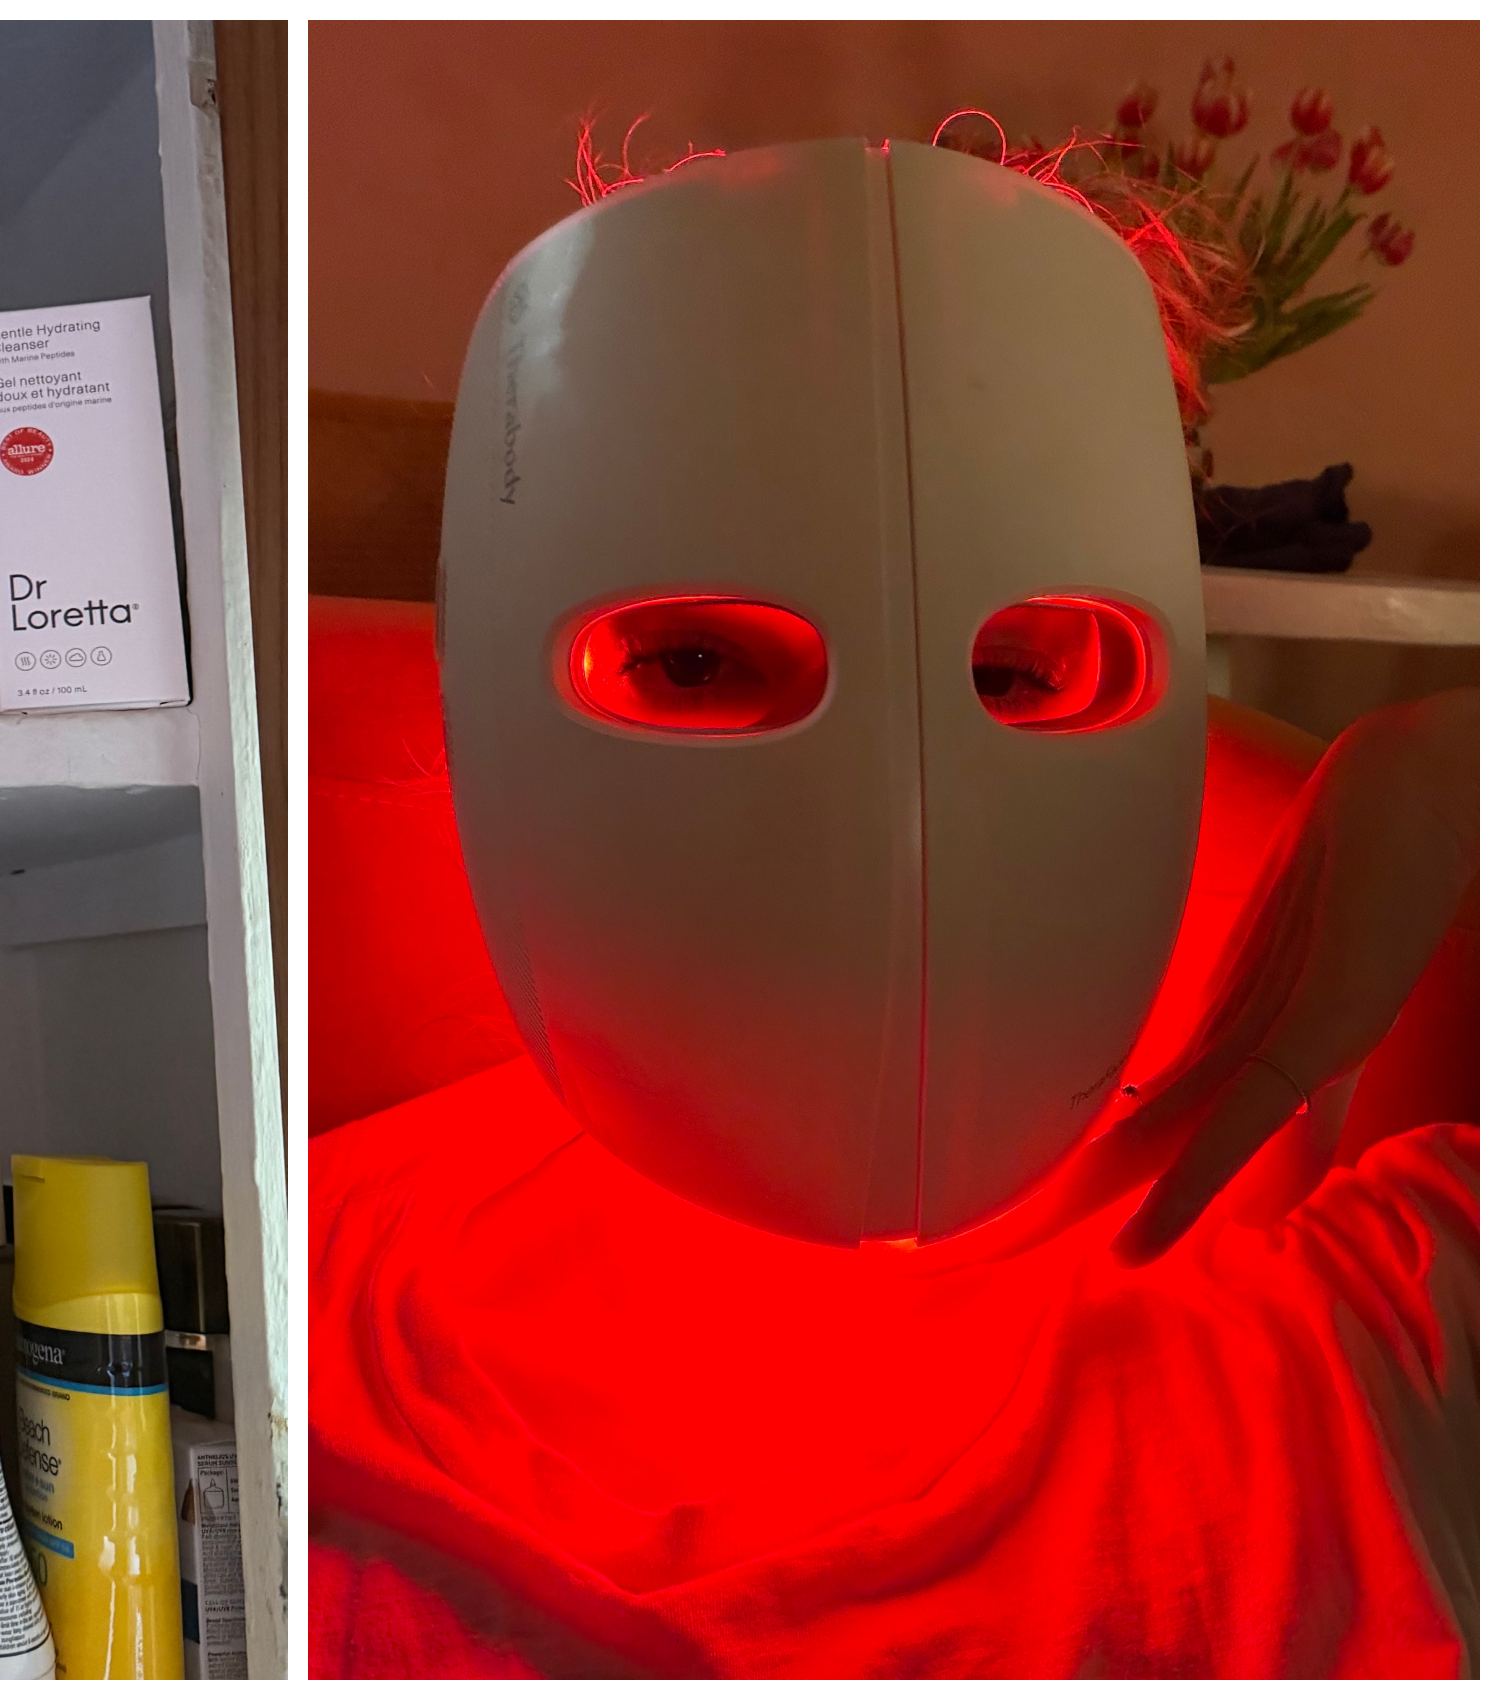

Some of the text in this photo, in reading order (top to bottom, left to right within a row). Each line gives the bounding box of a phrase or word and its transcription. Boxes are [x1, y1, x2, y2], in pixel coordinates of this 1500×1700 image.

[37, 320, 101, 338] Hydrating
[11, 354, 39, 363] Marine
[40, 350, 75, 361] Peptides
[20, 371, 81, 386] nettoyant
[31, 388, 44, 399] et
[46, 382, 110, 400] hydratant
[12, 401, 47, 413] peptides
[84, 397, 112, 405] marine
[7, 444, 46, 456] allure
[9, 573, 47, 602] Dr
[17, 689, 31, 697] 3.4
[57, 686, 72, 695] 100
[74, 685, 88, 694] mL
